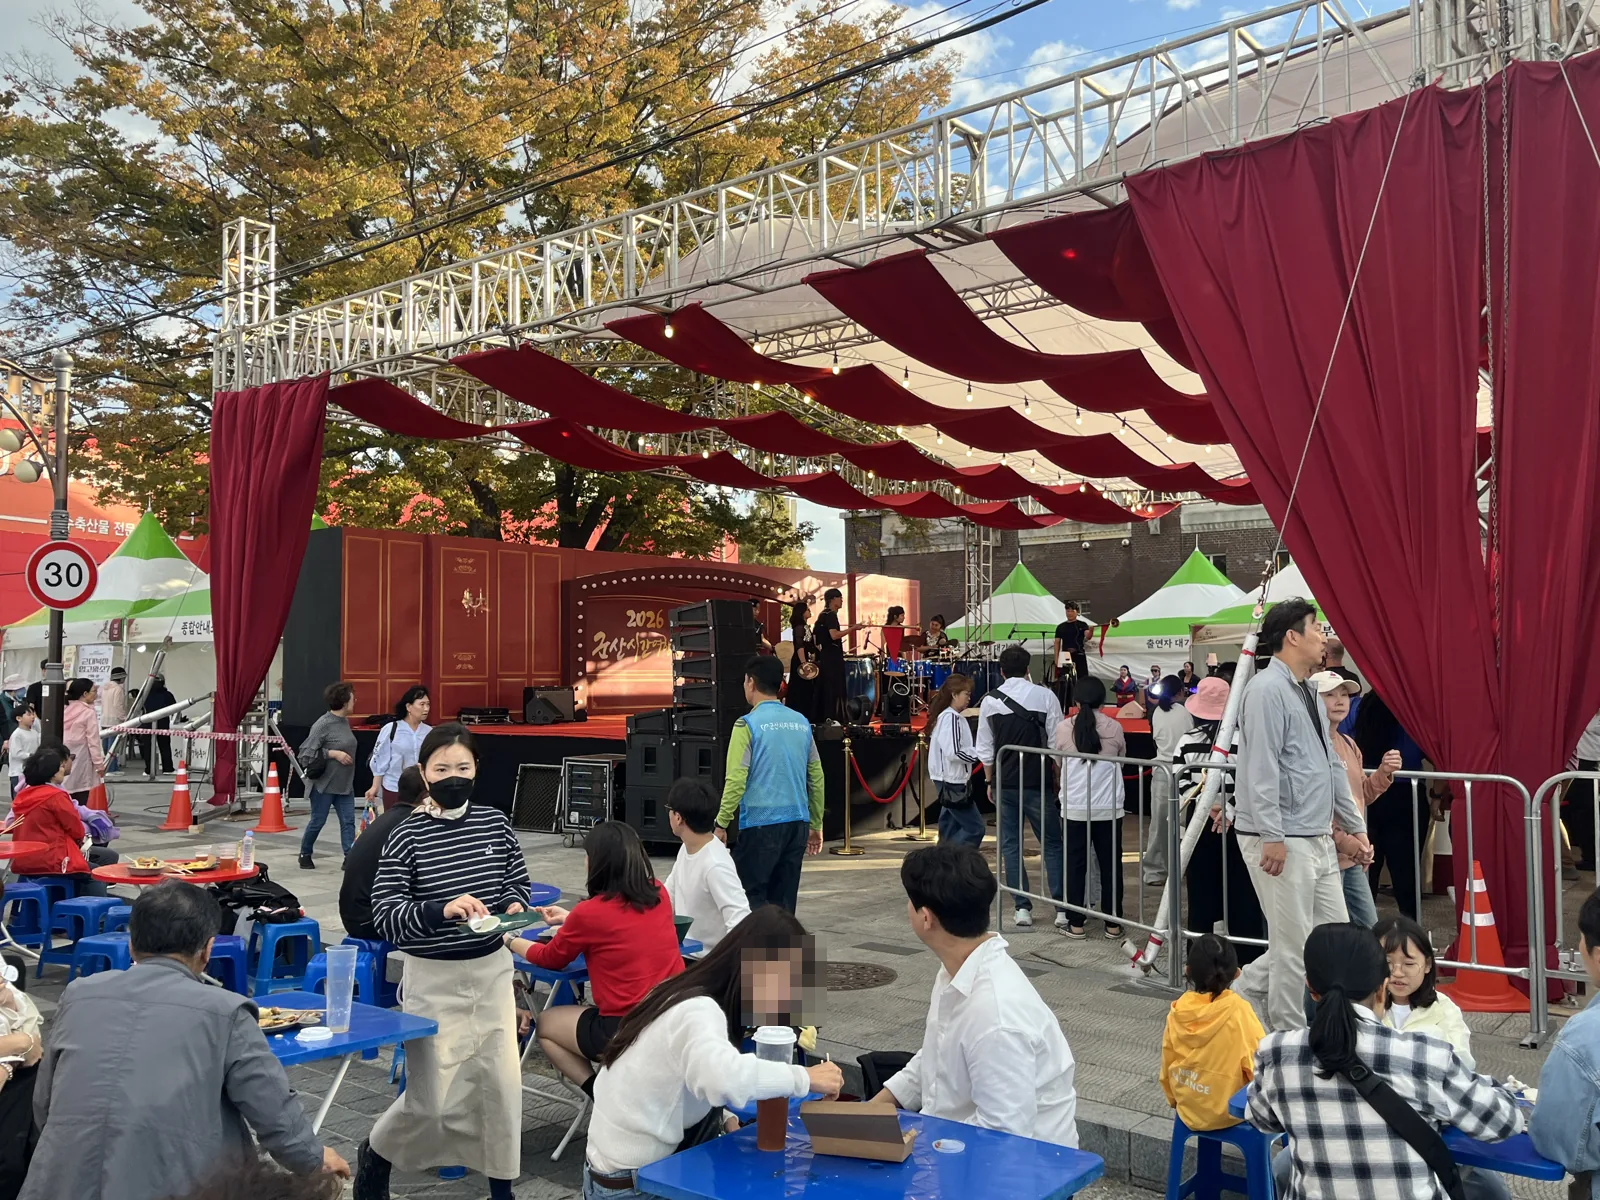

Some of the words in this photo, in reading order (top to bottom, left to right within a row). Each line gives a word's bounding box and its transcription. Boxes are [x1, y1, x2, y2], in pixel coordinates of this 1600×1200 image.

[44, 562, 83, 588] 30
[626, 609, 664, 629] 2026
[1146, 638, 1172, 649] 출연자
[1178, 1068, 1198, 1081] NEW
